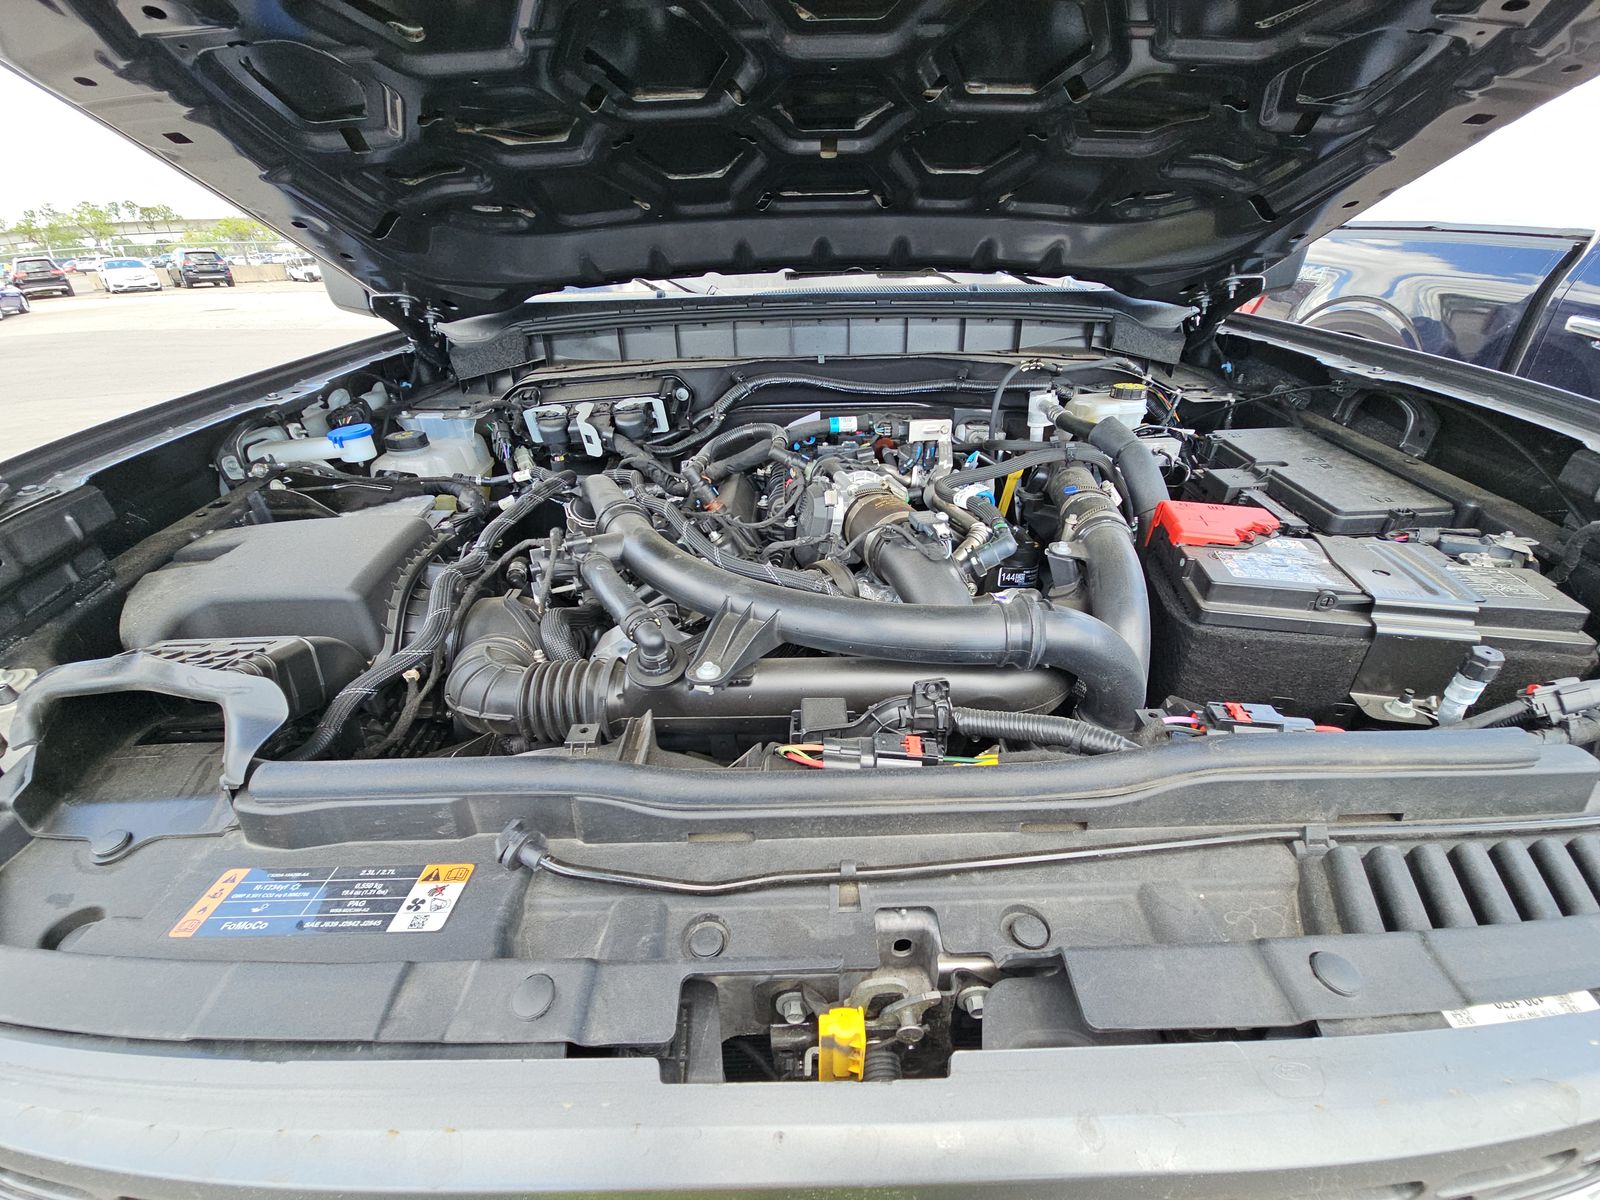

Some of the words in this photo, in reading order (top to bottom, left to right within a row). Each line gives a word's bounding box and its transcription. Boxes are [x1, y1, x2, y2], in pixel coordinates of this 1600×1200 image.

[1002, 573, 1015, 581] 144
[253, 884, 289, 892] R-1234yf
[373, 882, 383, 890] kg
[220, 921, 269, 930] FoMoCo
